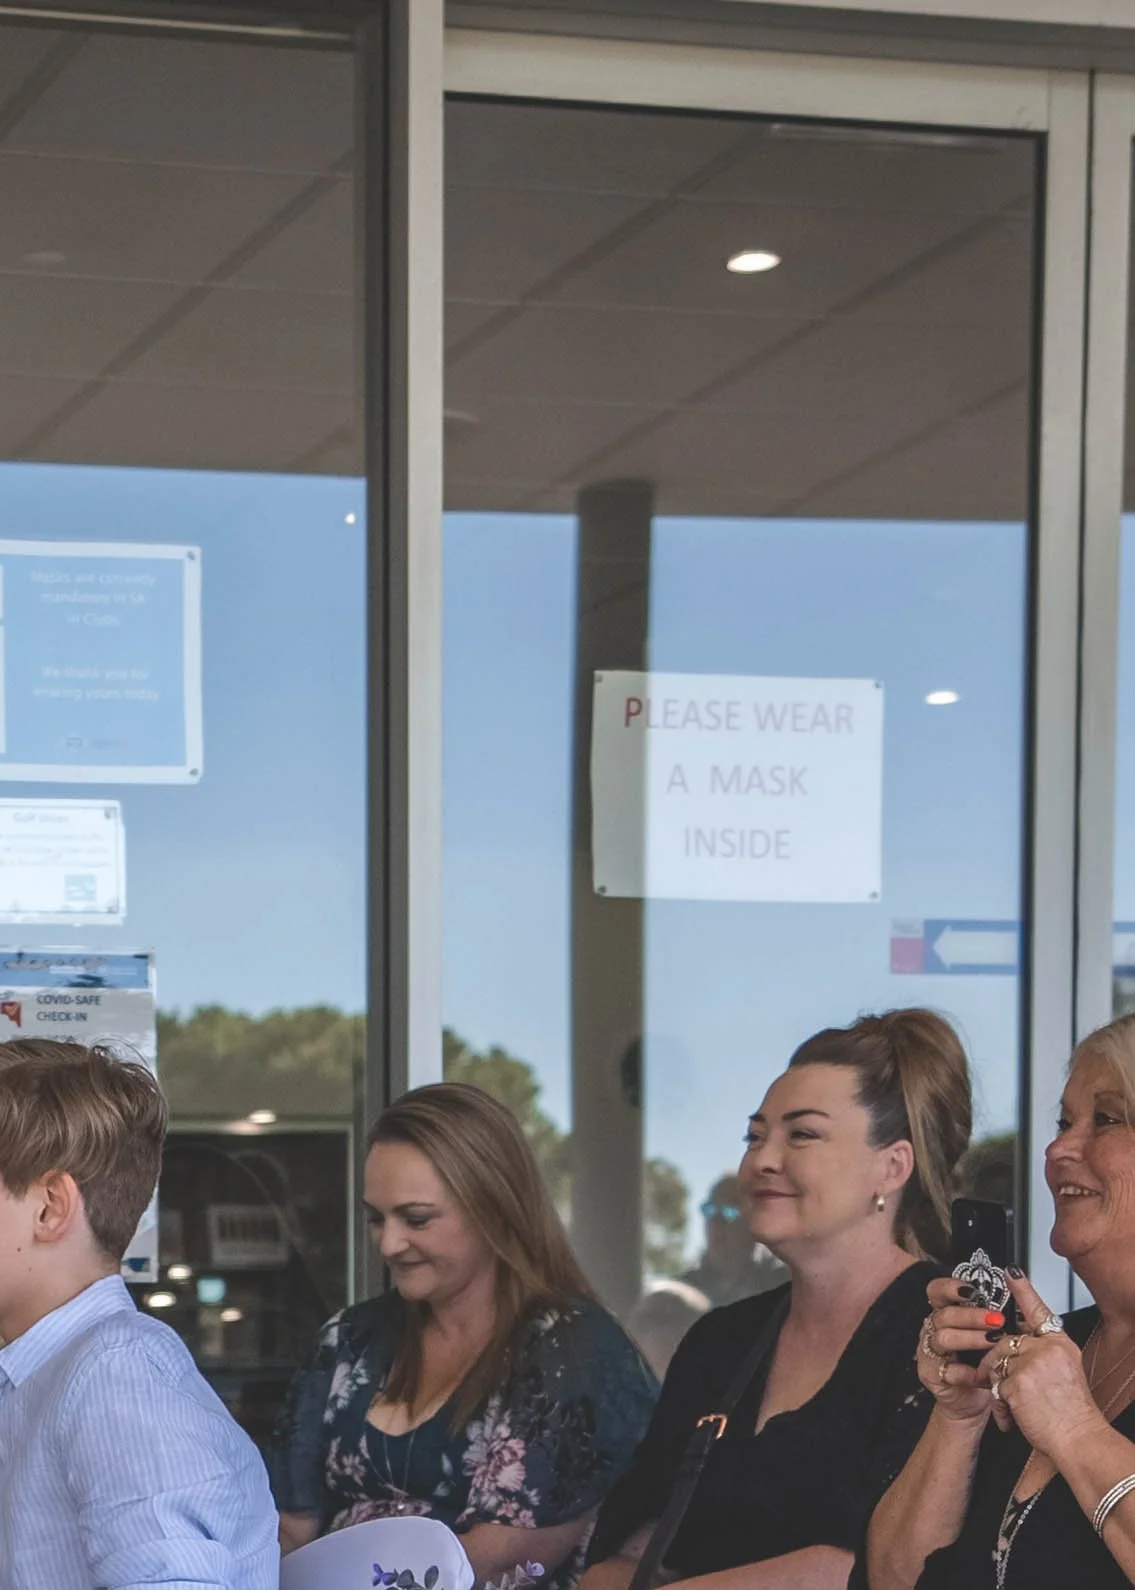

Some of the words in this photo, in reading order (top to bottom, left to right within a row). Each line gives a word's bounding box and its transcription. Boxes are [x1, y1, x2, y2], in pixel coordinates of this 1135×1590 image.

[624, 696, 742, 731] PLEASE
[753, 702, 855, 734] WEAR
[666, 764, 689, 794] A
[710, 765, 809, 796] MASK
[684, 826, 792, 860] INSIDE
[36, 994, 102, 1006] COVID-SAFE
[36, 1010, 88, 1022] CHECK-IN
